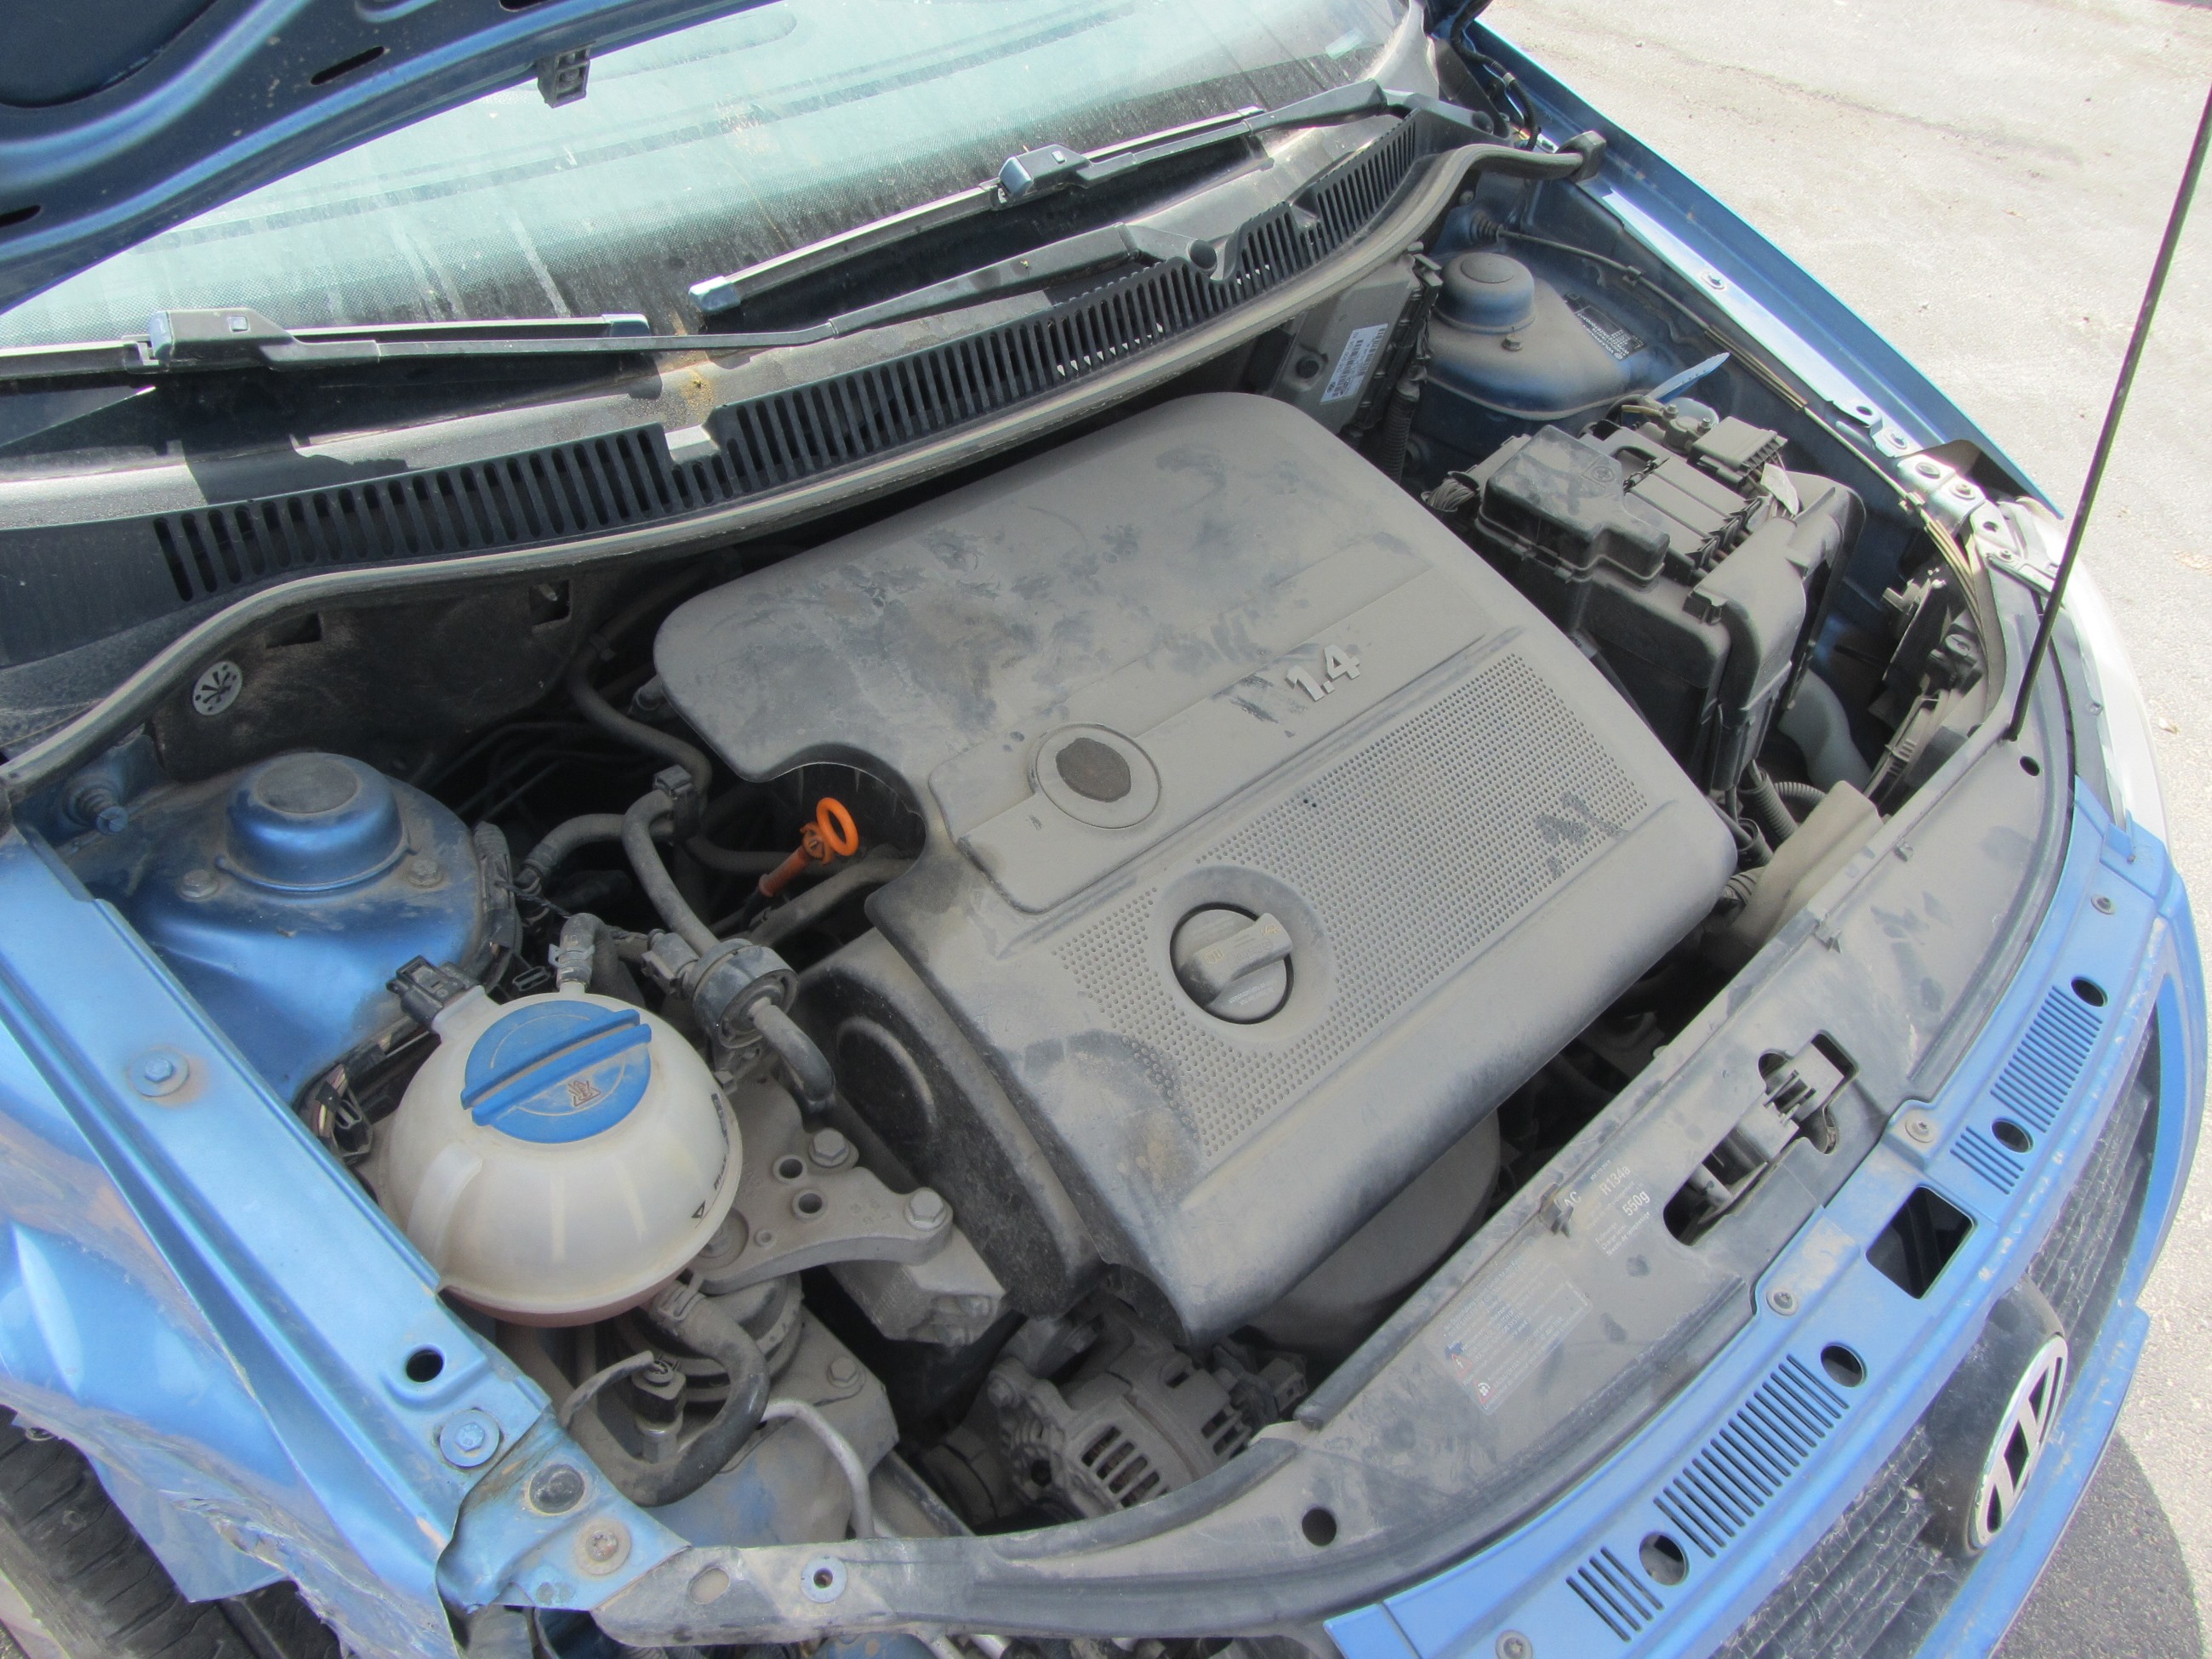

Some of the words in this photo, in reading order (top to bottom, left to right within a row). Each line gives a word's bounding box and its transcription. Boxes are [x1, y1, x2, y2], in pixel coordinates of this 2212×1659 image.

[1286, 643, 1360, 702] 1.4
[1599, 1166, 1631, 1195] R134a
[1622, 1190, 1650, 1217] 550g
